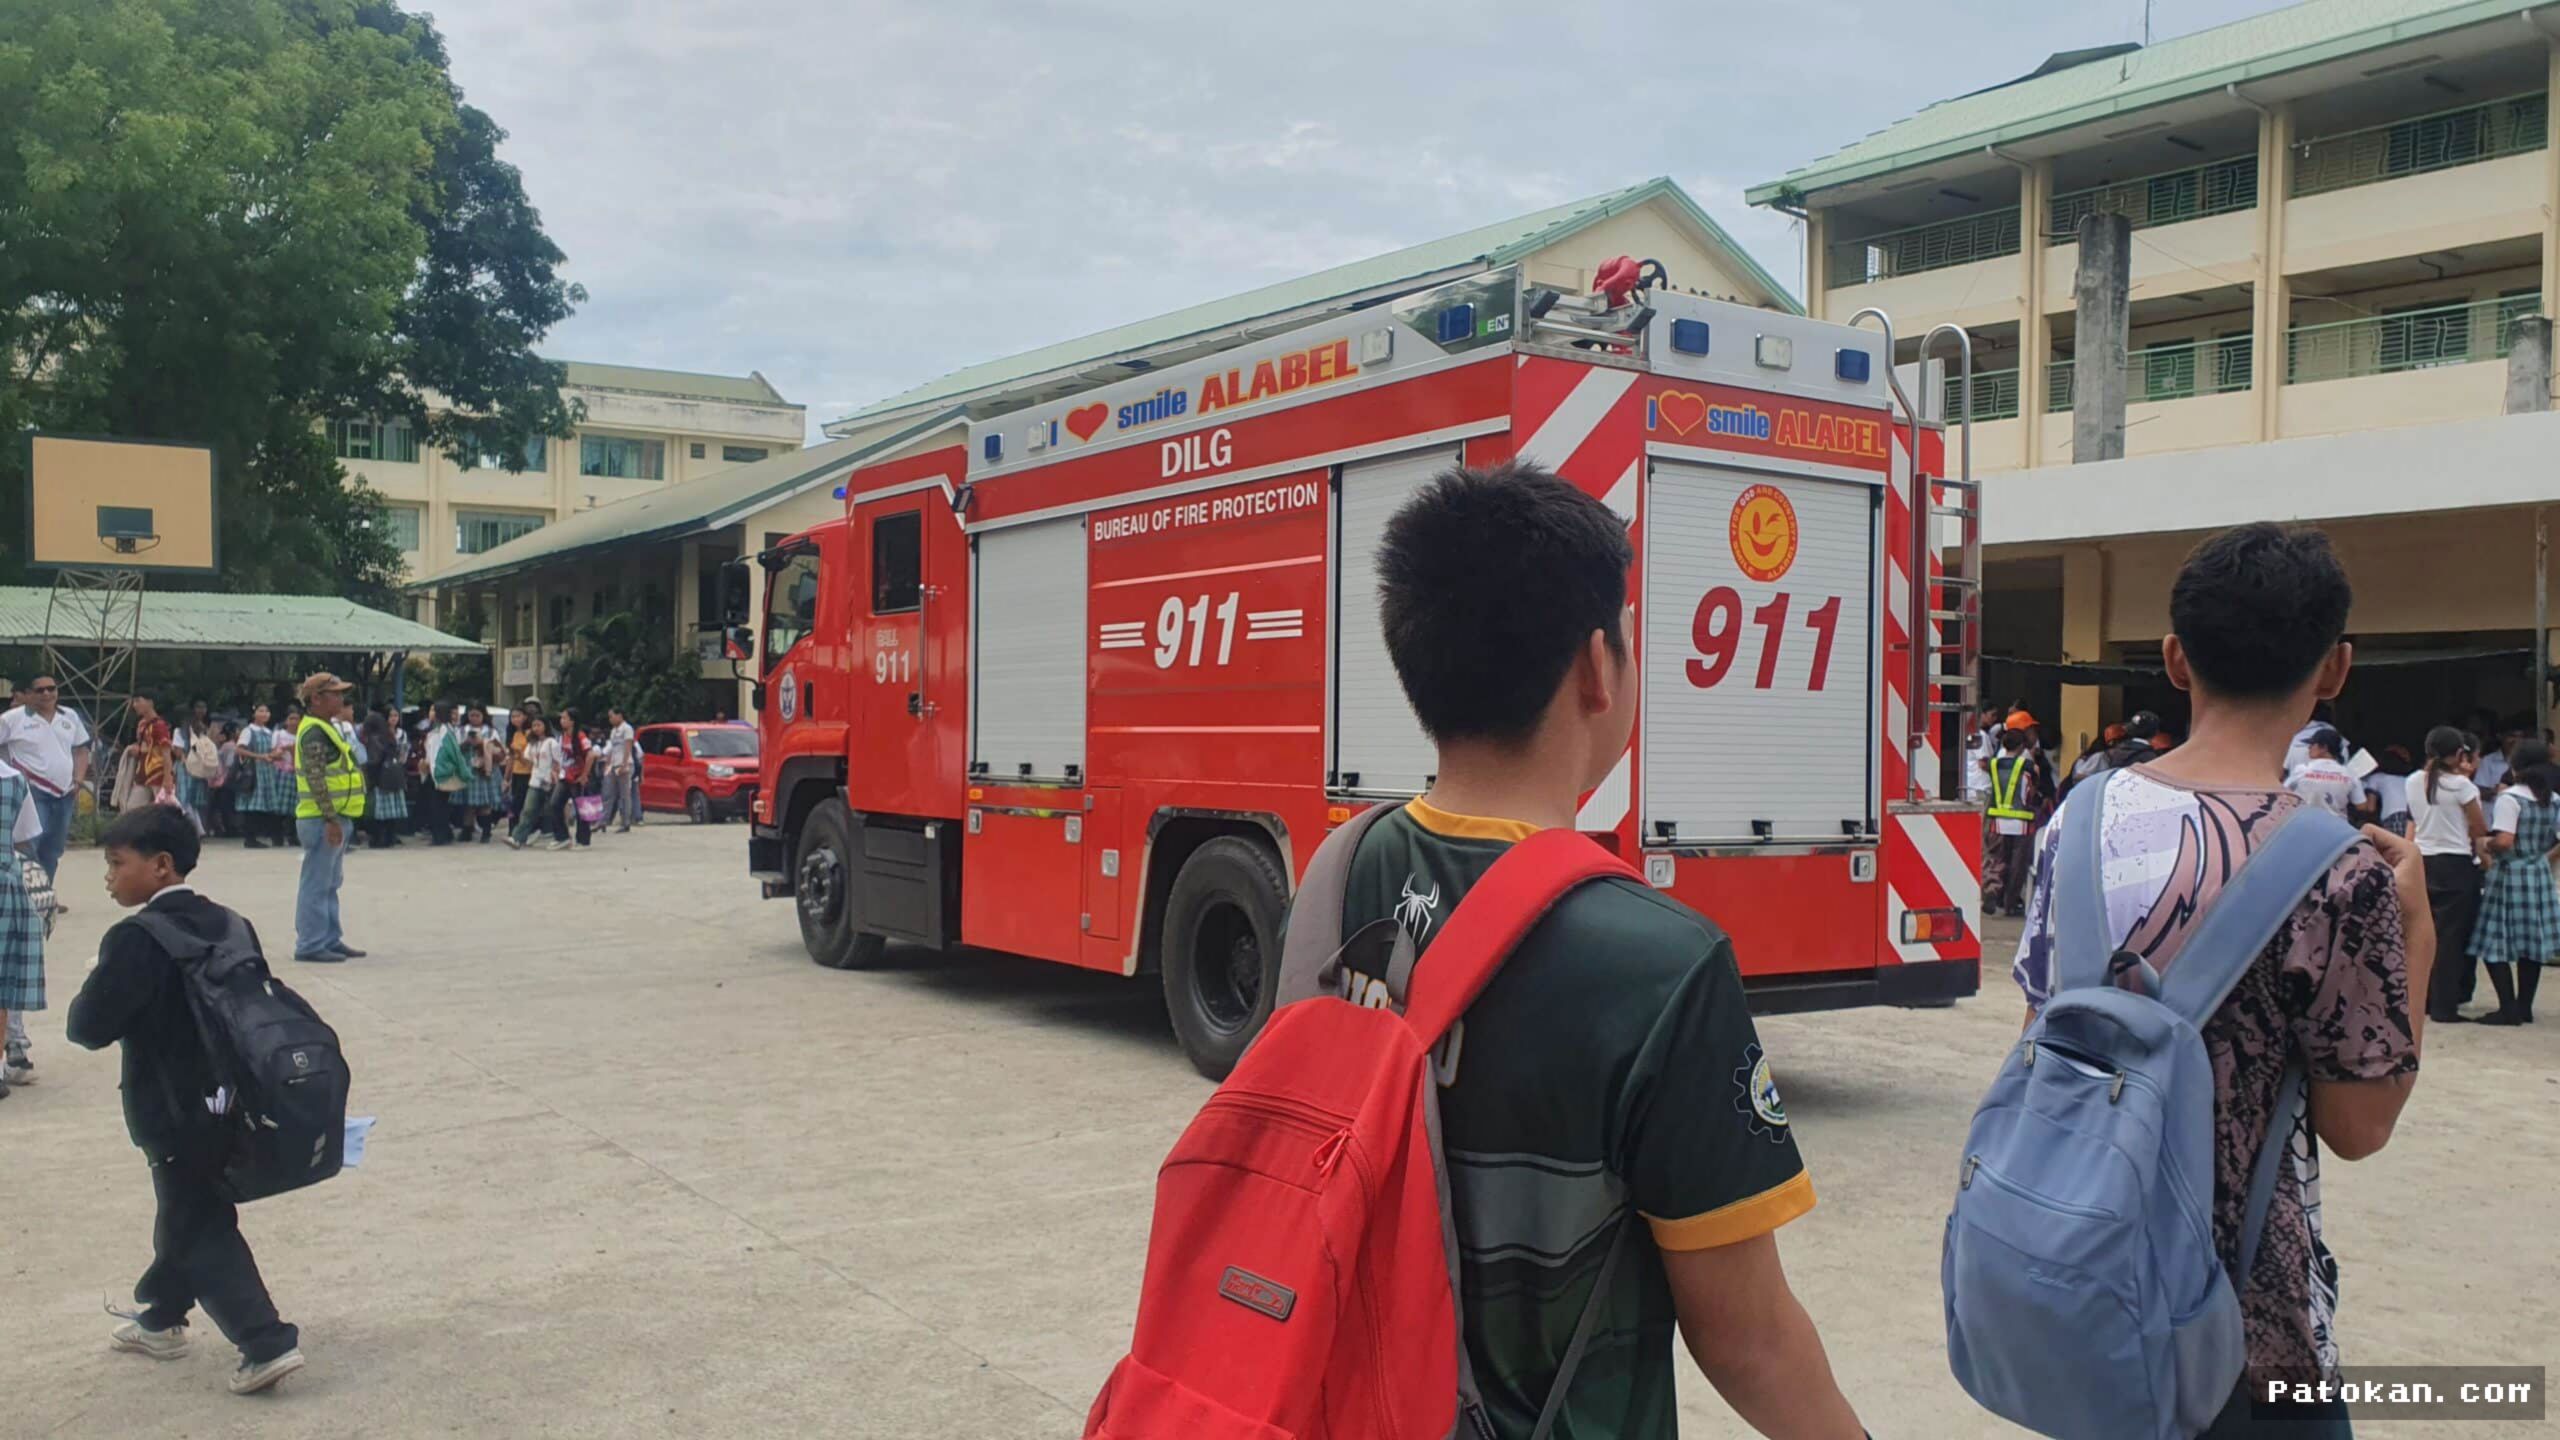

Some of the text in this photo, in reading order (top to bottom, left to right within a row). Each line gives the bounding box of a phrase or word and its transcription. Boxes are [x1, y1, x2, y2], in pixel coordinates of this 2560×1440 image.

[1050, 339, 1358, 447] I smile ALABEL
[1161, 428, 1232, 478] DILG
[1646, 395, 1887, 459] I smile ALABEL
[1094, 482, 1319, 542] BUREAU OF FIRE PROTECTION
[1154, 592, 1239, 669] 911
[1685, 585, 1842, 691] 911
[876, 650, 909, 684] 911
